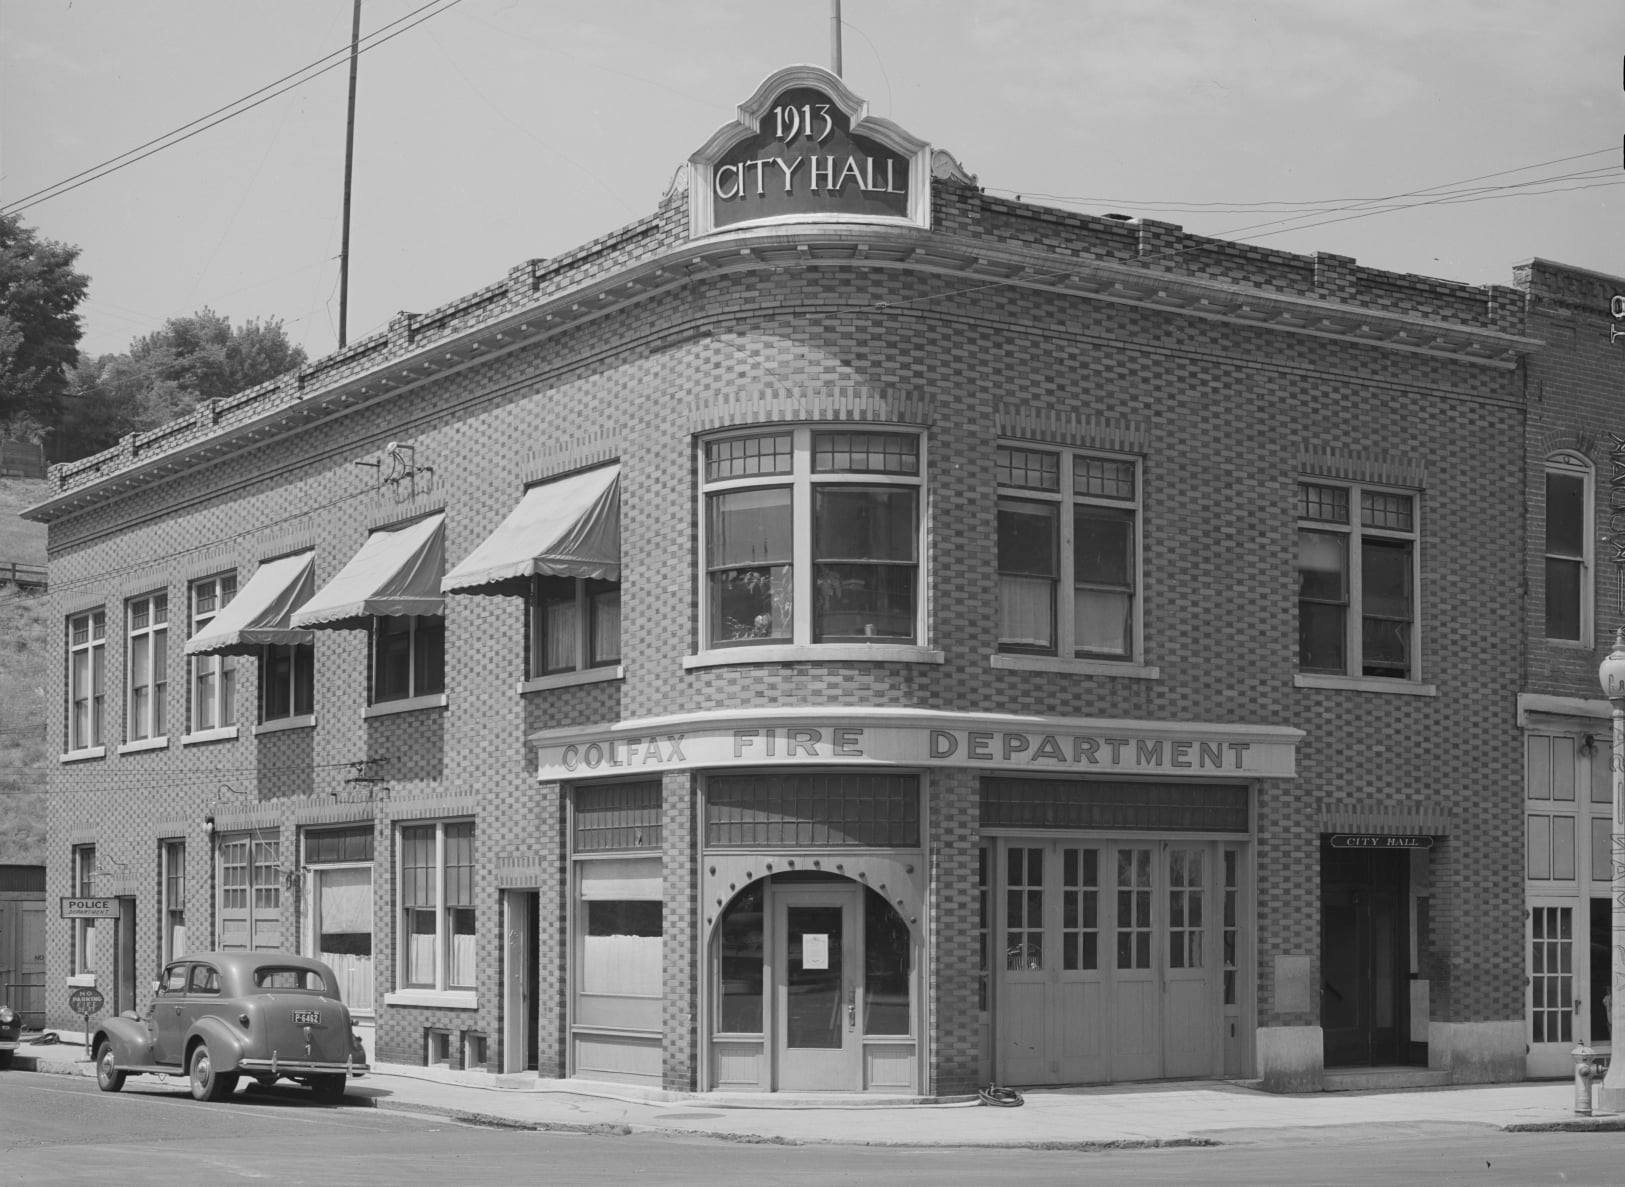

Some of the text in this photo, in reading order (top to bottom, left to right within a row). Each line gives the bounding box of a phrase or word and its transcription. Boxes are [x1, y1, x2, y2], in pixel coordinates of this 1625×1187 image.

[773, 103, 833, 144] 1913
[715, 154, 906, 199] CITY HALL
[561, 727, 1251, 772] COLFAX FIRE DEPARTMENT
[1346, 837, 1419, 846] CITY HALL
[69, 901, 110, 909] POLICE
